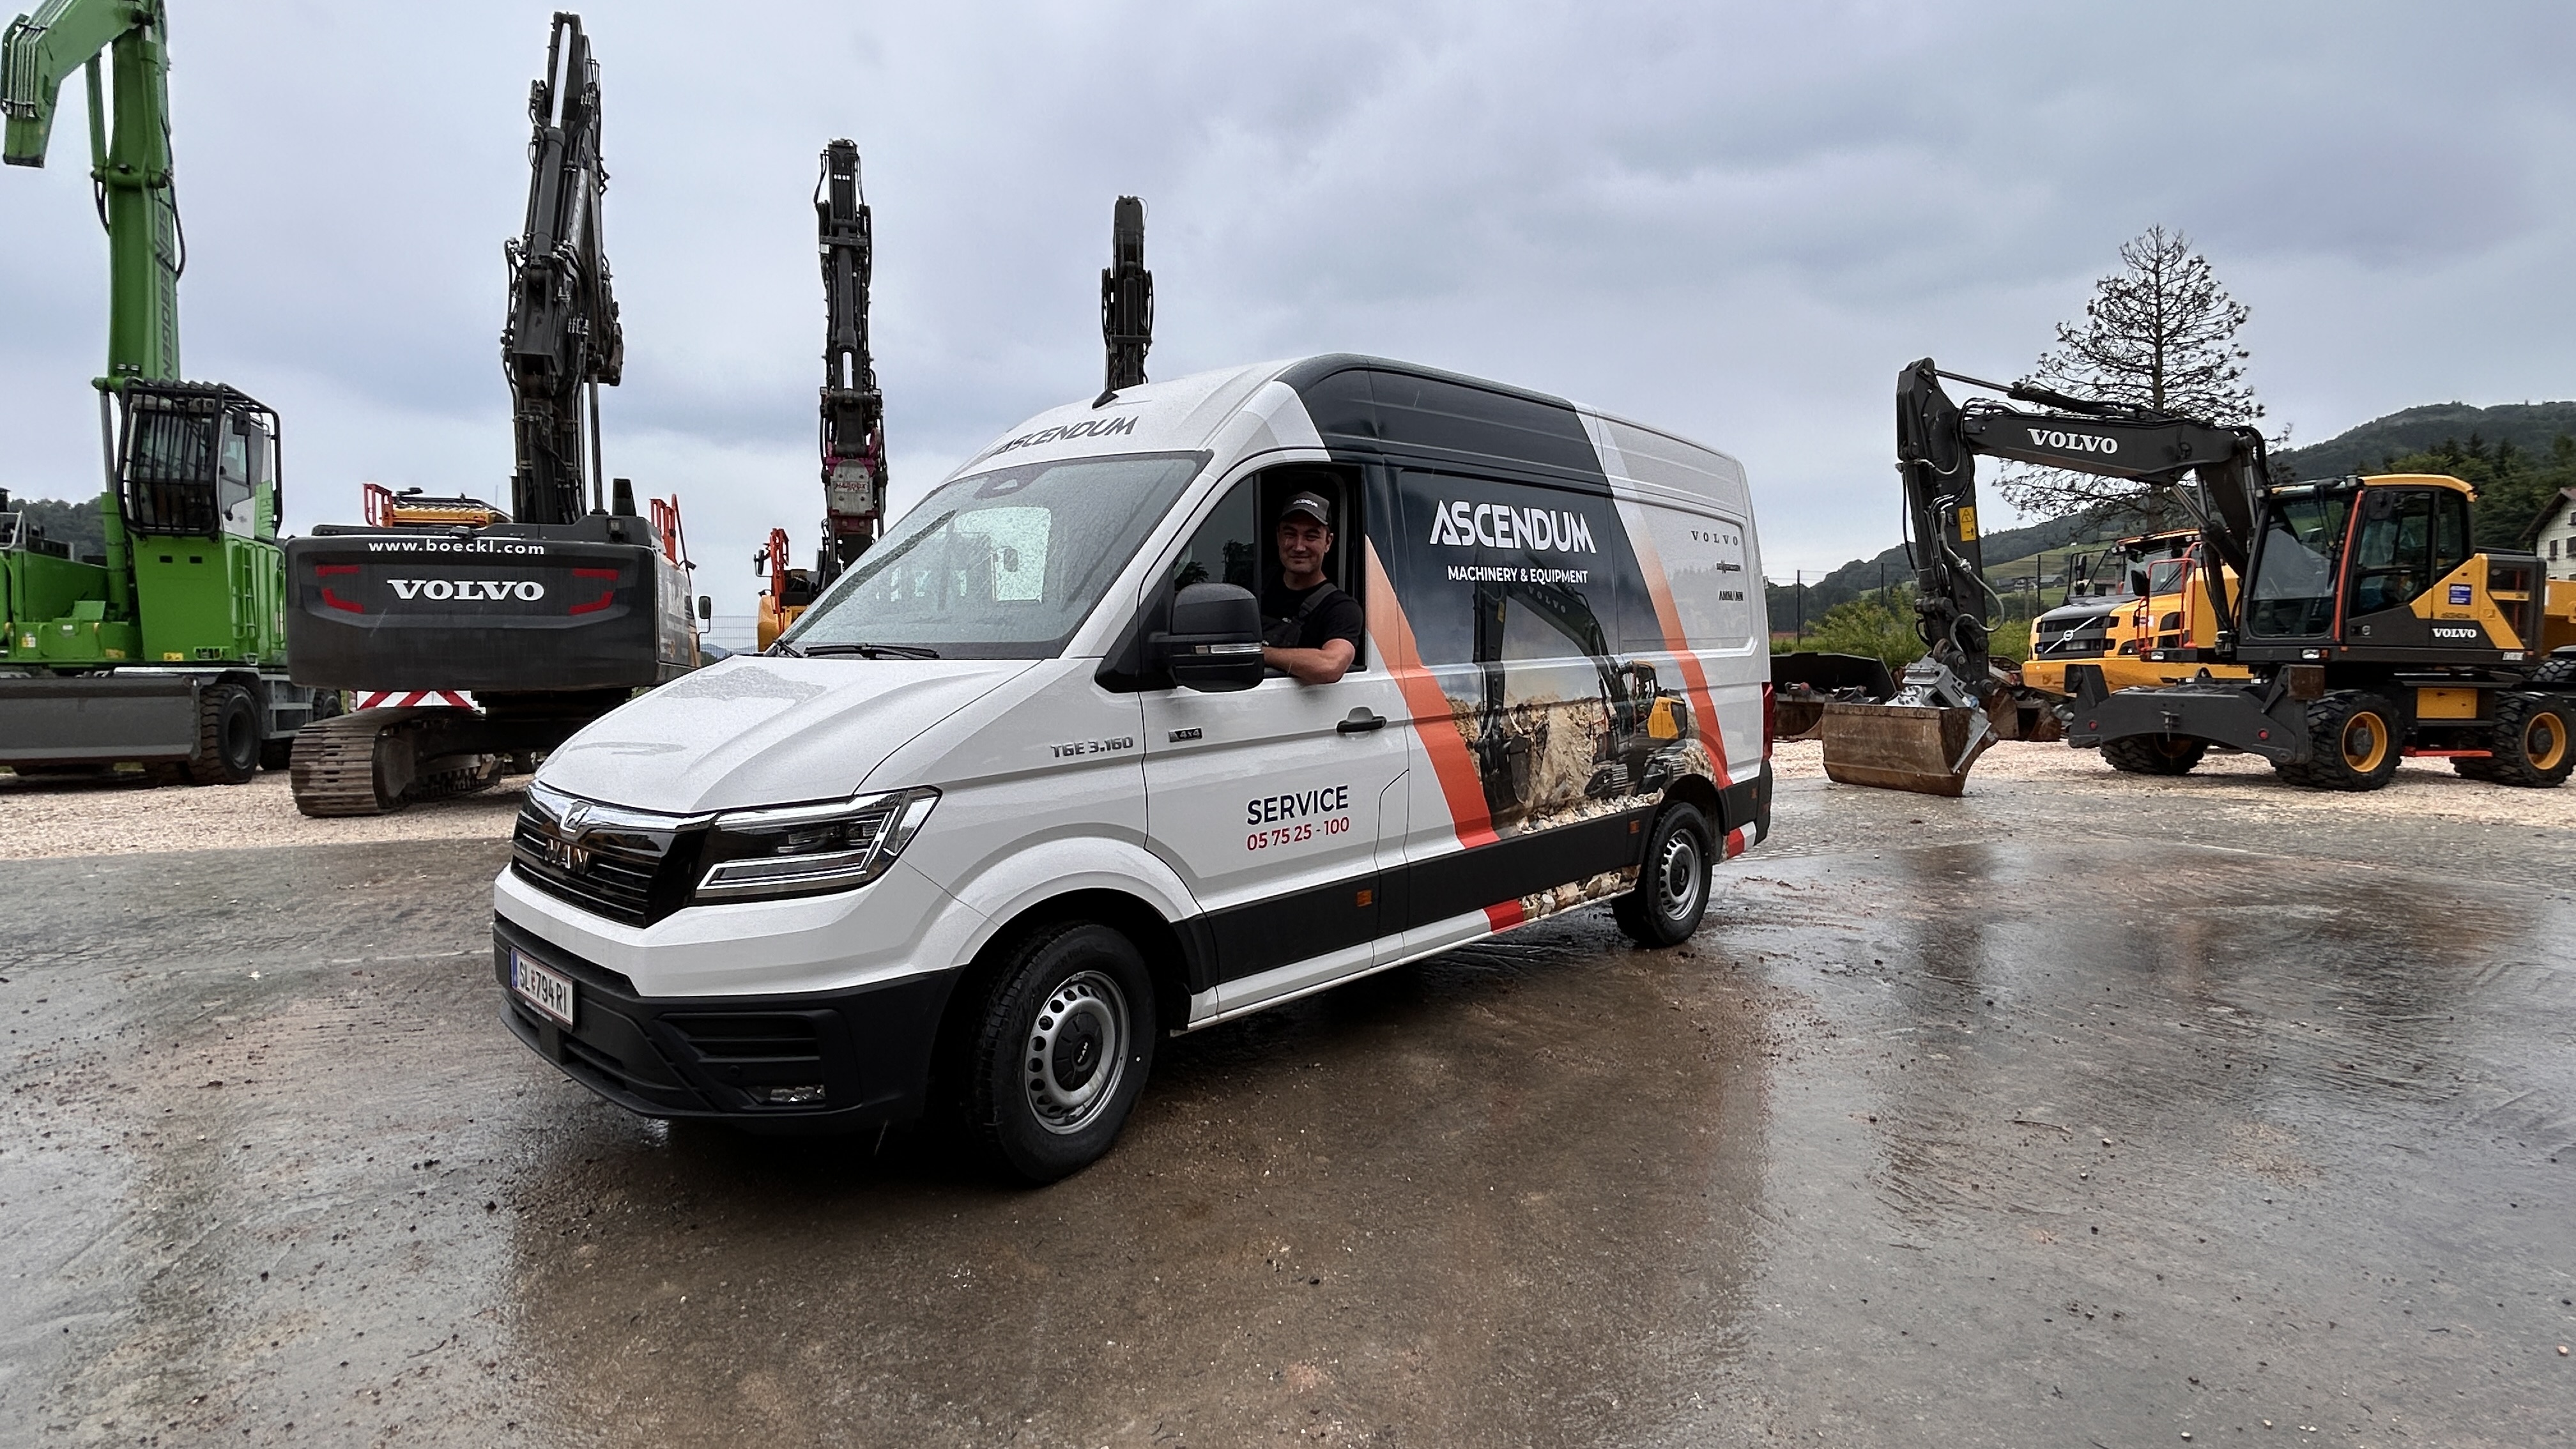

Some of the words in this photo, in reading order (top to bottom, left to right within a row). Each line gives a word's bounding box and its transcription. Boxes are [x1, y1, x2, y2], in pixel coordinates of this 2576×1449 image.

[987, 416, 1138, 459] ASCENDUM
[2027, 428, 2118, 454] VOLVO
[1430, 500, 1597, 553] ASCENDUM
[1690, 530, 1738, 546] VOLVO
[368, 539, 545, 555] www.boeckl.com
[1448, 565, 1517, 582] MACHINERY
[1520, 568, 1528, 582] &
[1530, 568, 1588, 585] EQUIPMENT
[387, 579, 544, 601] VOLVO
[1528, 585, 1566, 613] VOLVO
[2432, 628, 2477, 638] VOLVO
[1050, 741, 1085, 758] TGE
[1088, 736, 1133, 753] 3.160
[1247, 785, 1348, 825] SERVICE
[1247, 832, 1268, 850] 05
[1271, 827, 1291, 846] 75
[1294, 824, 1312, 842] 25
[1324, 816, 1349, 835] 100
[544, 838, 589, 875] MAN
